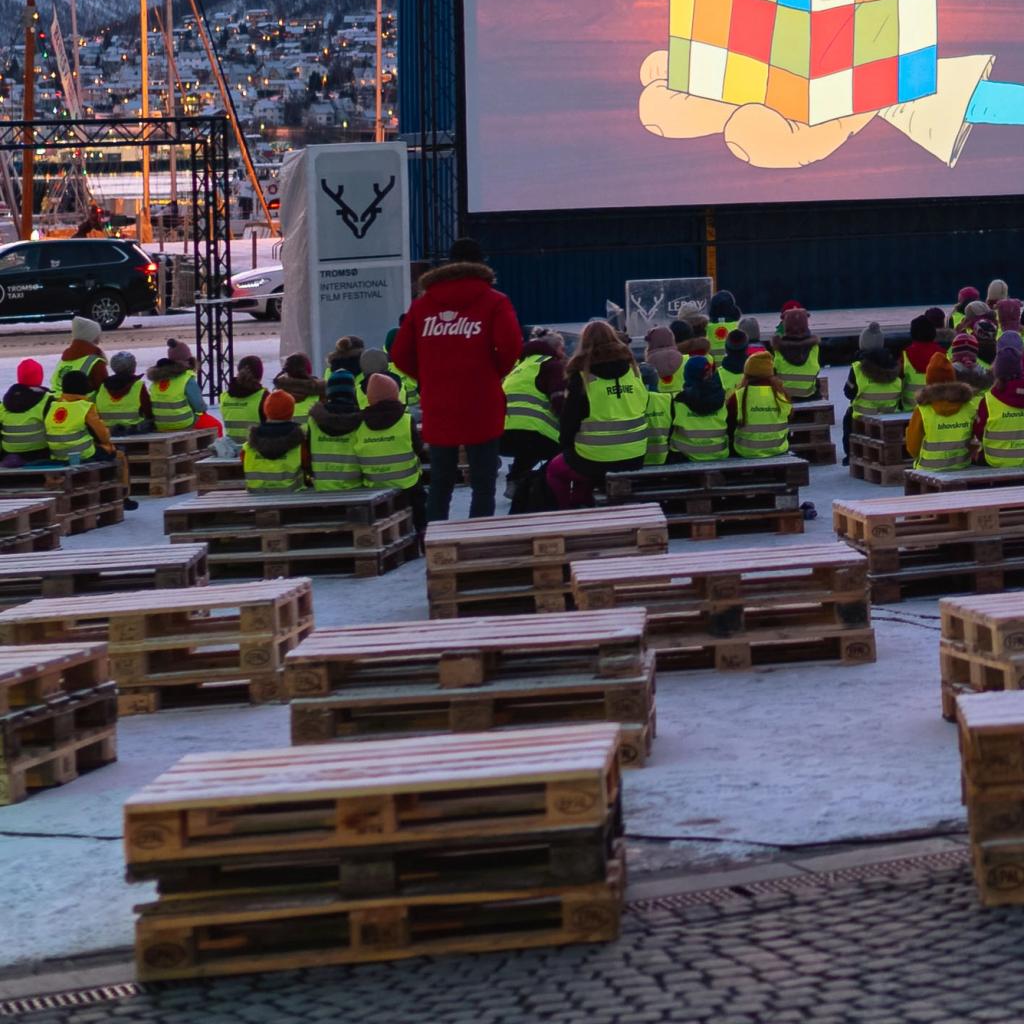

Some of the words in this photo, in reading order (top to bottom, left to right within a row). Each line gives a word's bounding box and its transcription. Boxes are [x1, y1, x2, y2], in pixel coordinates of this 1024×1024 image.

[320, 268, 358, 278] TROMSØ
[320, 279, 388, 291] INTERNATIONAL
[7, 292, 24, 300] TAXI
[320, 293, 341, 302] FILM
[342, 291, 383, 301] FESTIVAL
[421, 316, 482, 339] Nordlys
